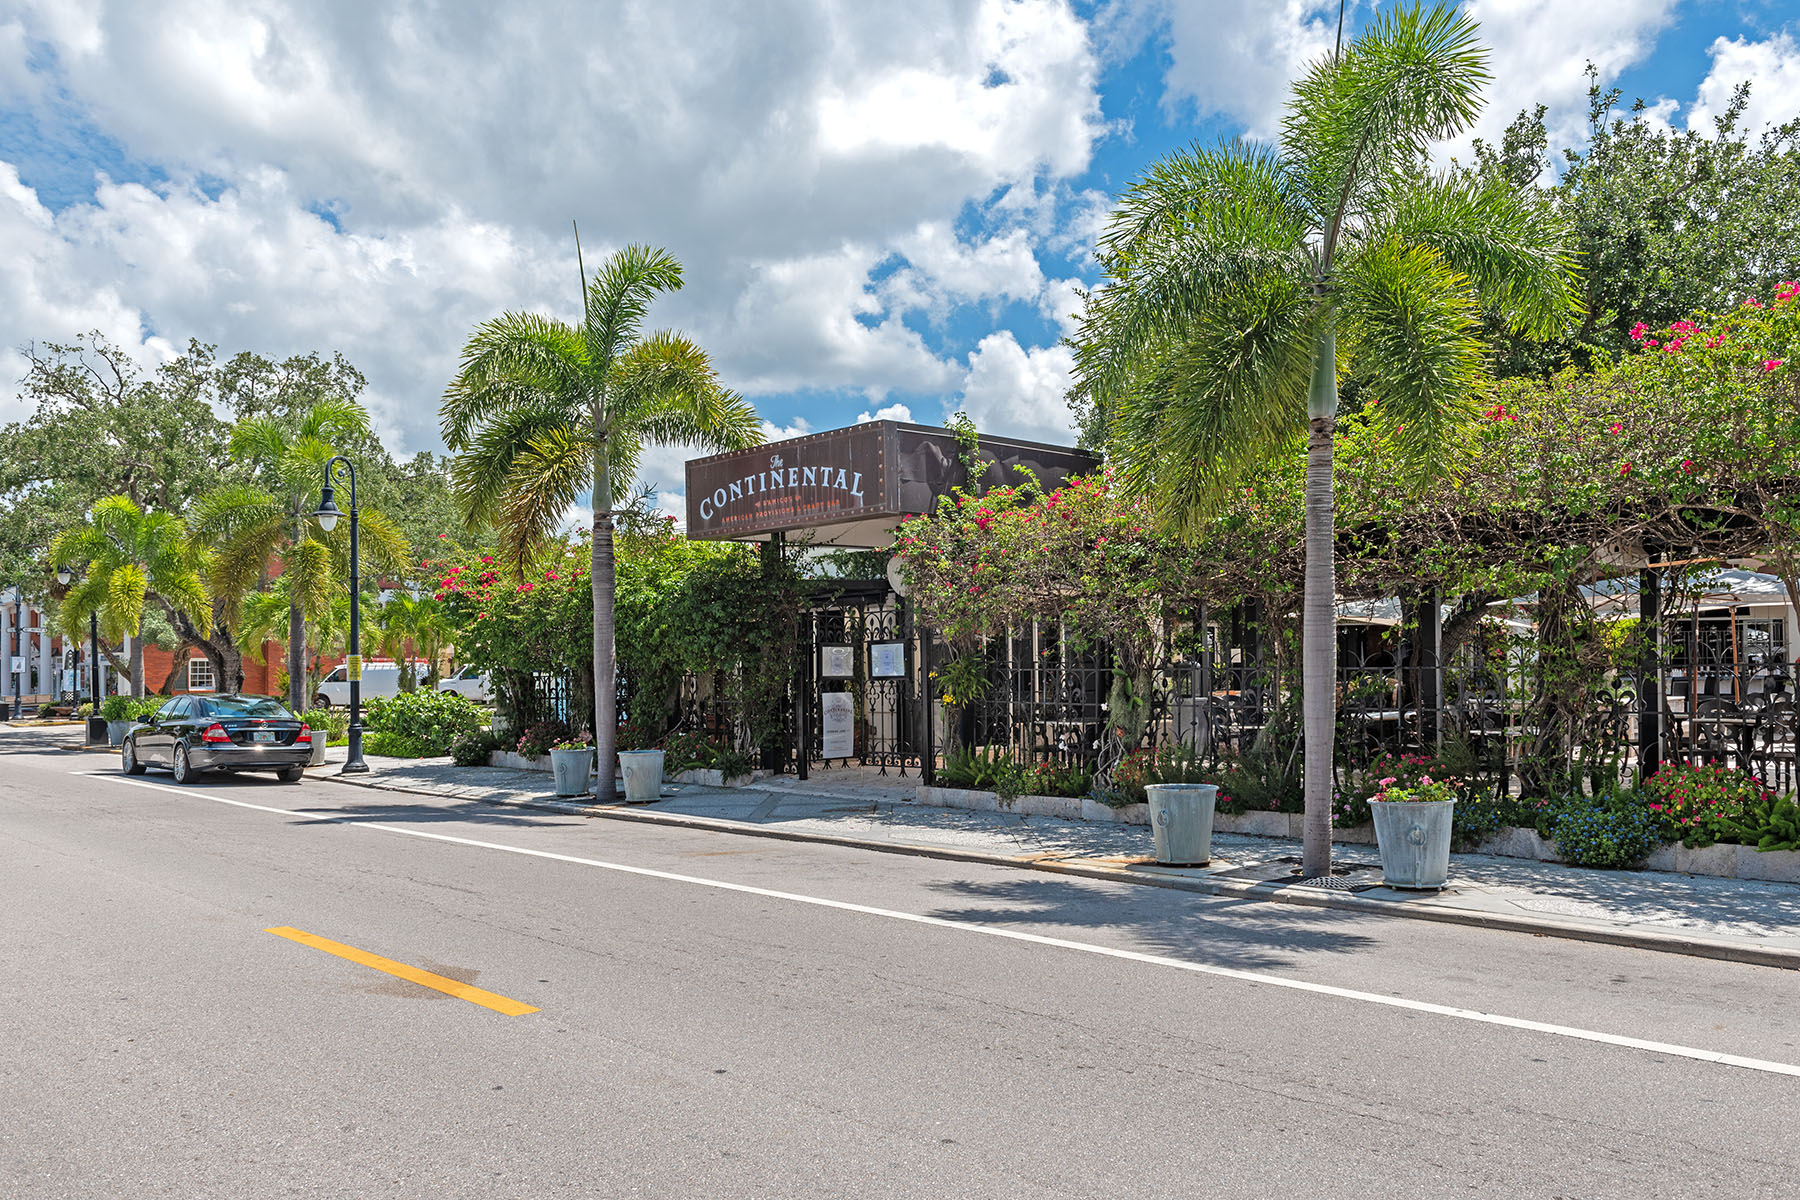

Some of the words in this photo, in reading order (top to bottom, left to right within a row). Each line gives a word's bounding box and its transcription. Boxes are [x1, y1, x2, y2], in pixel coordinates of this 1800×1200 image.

[770, 454, 784, 469] The
[699, 466, 865, 520] CONTINENTAL
[721, 513, 753, 523] AMERICAN
[755, 506, 794, 518] PROVISIONS
